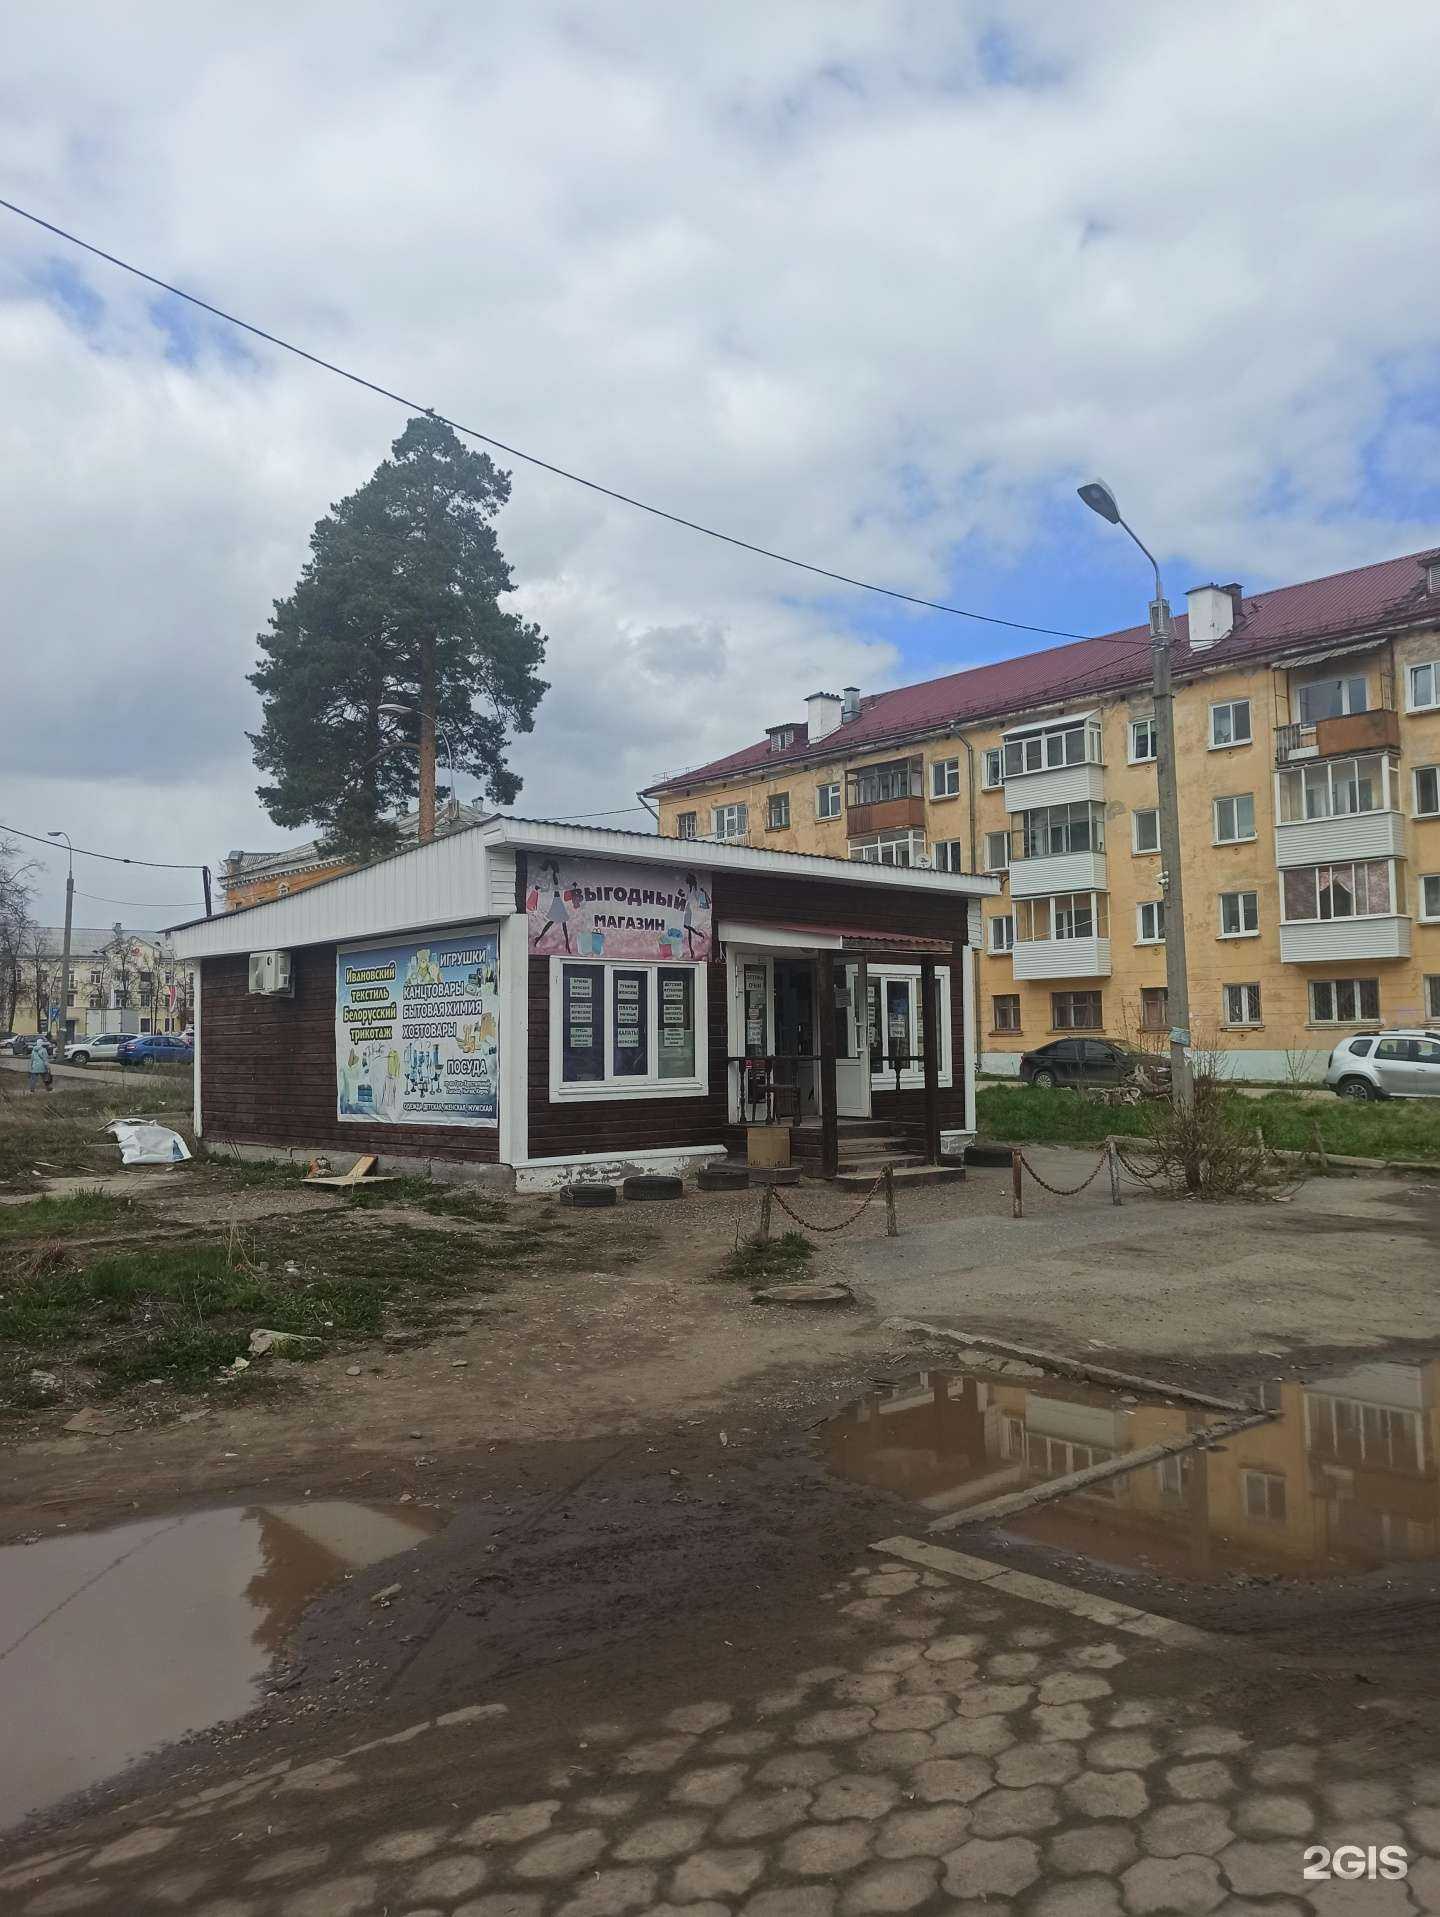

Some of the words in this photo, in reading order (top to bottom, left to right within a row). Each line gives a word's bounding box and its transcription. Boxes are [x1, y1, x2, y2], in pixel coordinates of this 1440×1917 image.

[571, 886, 688, 912] ВЫГОДНЫЙ
[593, 914, 666, 931] МАГАЗИН
[440, 950, 487, 968] ИГРУШКИ
[346, 962, 396, 985] Ивановский
[351, 986, 389, 1003] текстиль
[403, 981, 465, 1001] КАНЦТОВАРЫ
[343, 1003, 397, 1025] Белорусский
[403, 1002, 446, 1019] БЫТОВАЯ
[446, 999, 483, 1017] ХИМИЯ
[350, 1026, 393, 1044] трикотаж
[402, 1022, 457, 1039] ХОЗТОВАРЫ
[446, 1059, 487, 1077] ПОСУДА
